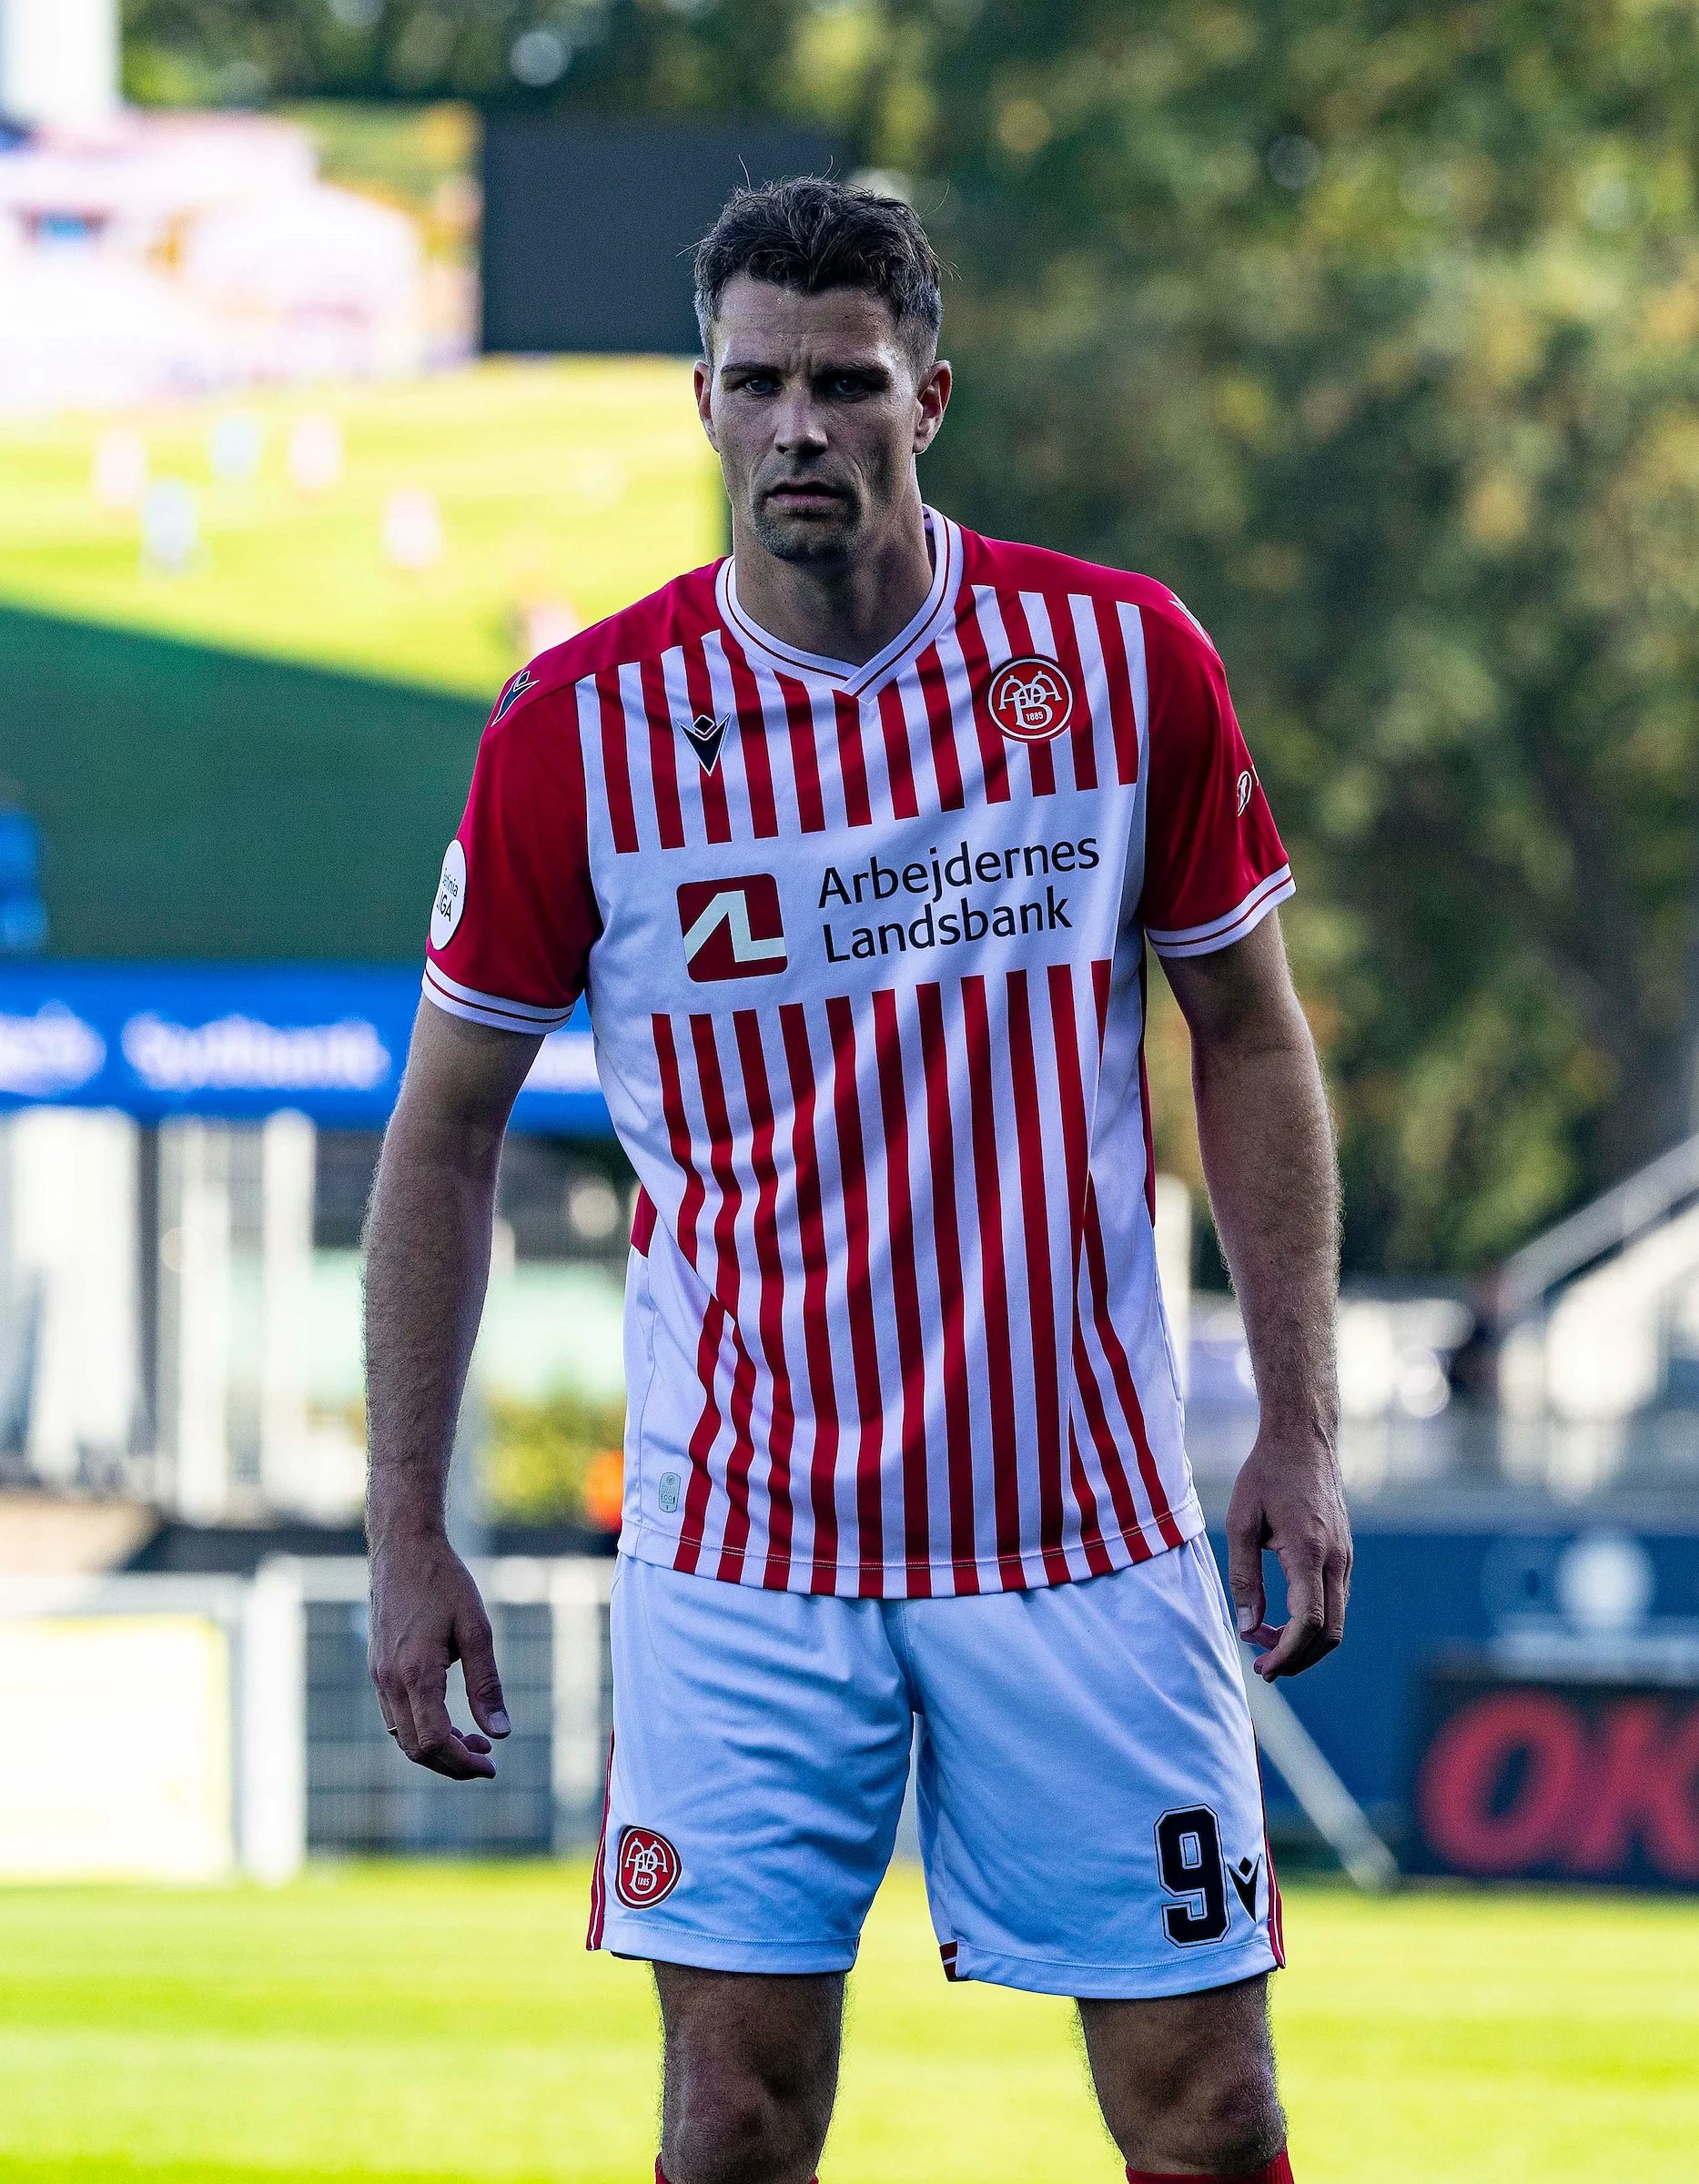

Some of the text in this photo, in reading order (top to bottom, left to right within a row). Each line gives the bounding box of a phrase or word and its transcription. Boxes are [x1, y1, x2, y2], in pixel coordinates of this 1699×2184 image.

[1026, 711, 1043, 721] 1885
[818, 836, 1100, 908] Arbejdernes
[823, 886, 1073, 963] Landsbank
[1153, 1804, 1232, 1949] 9
